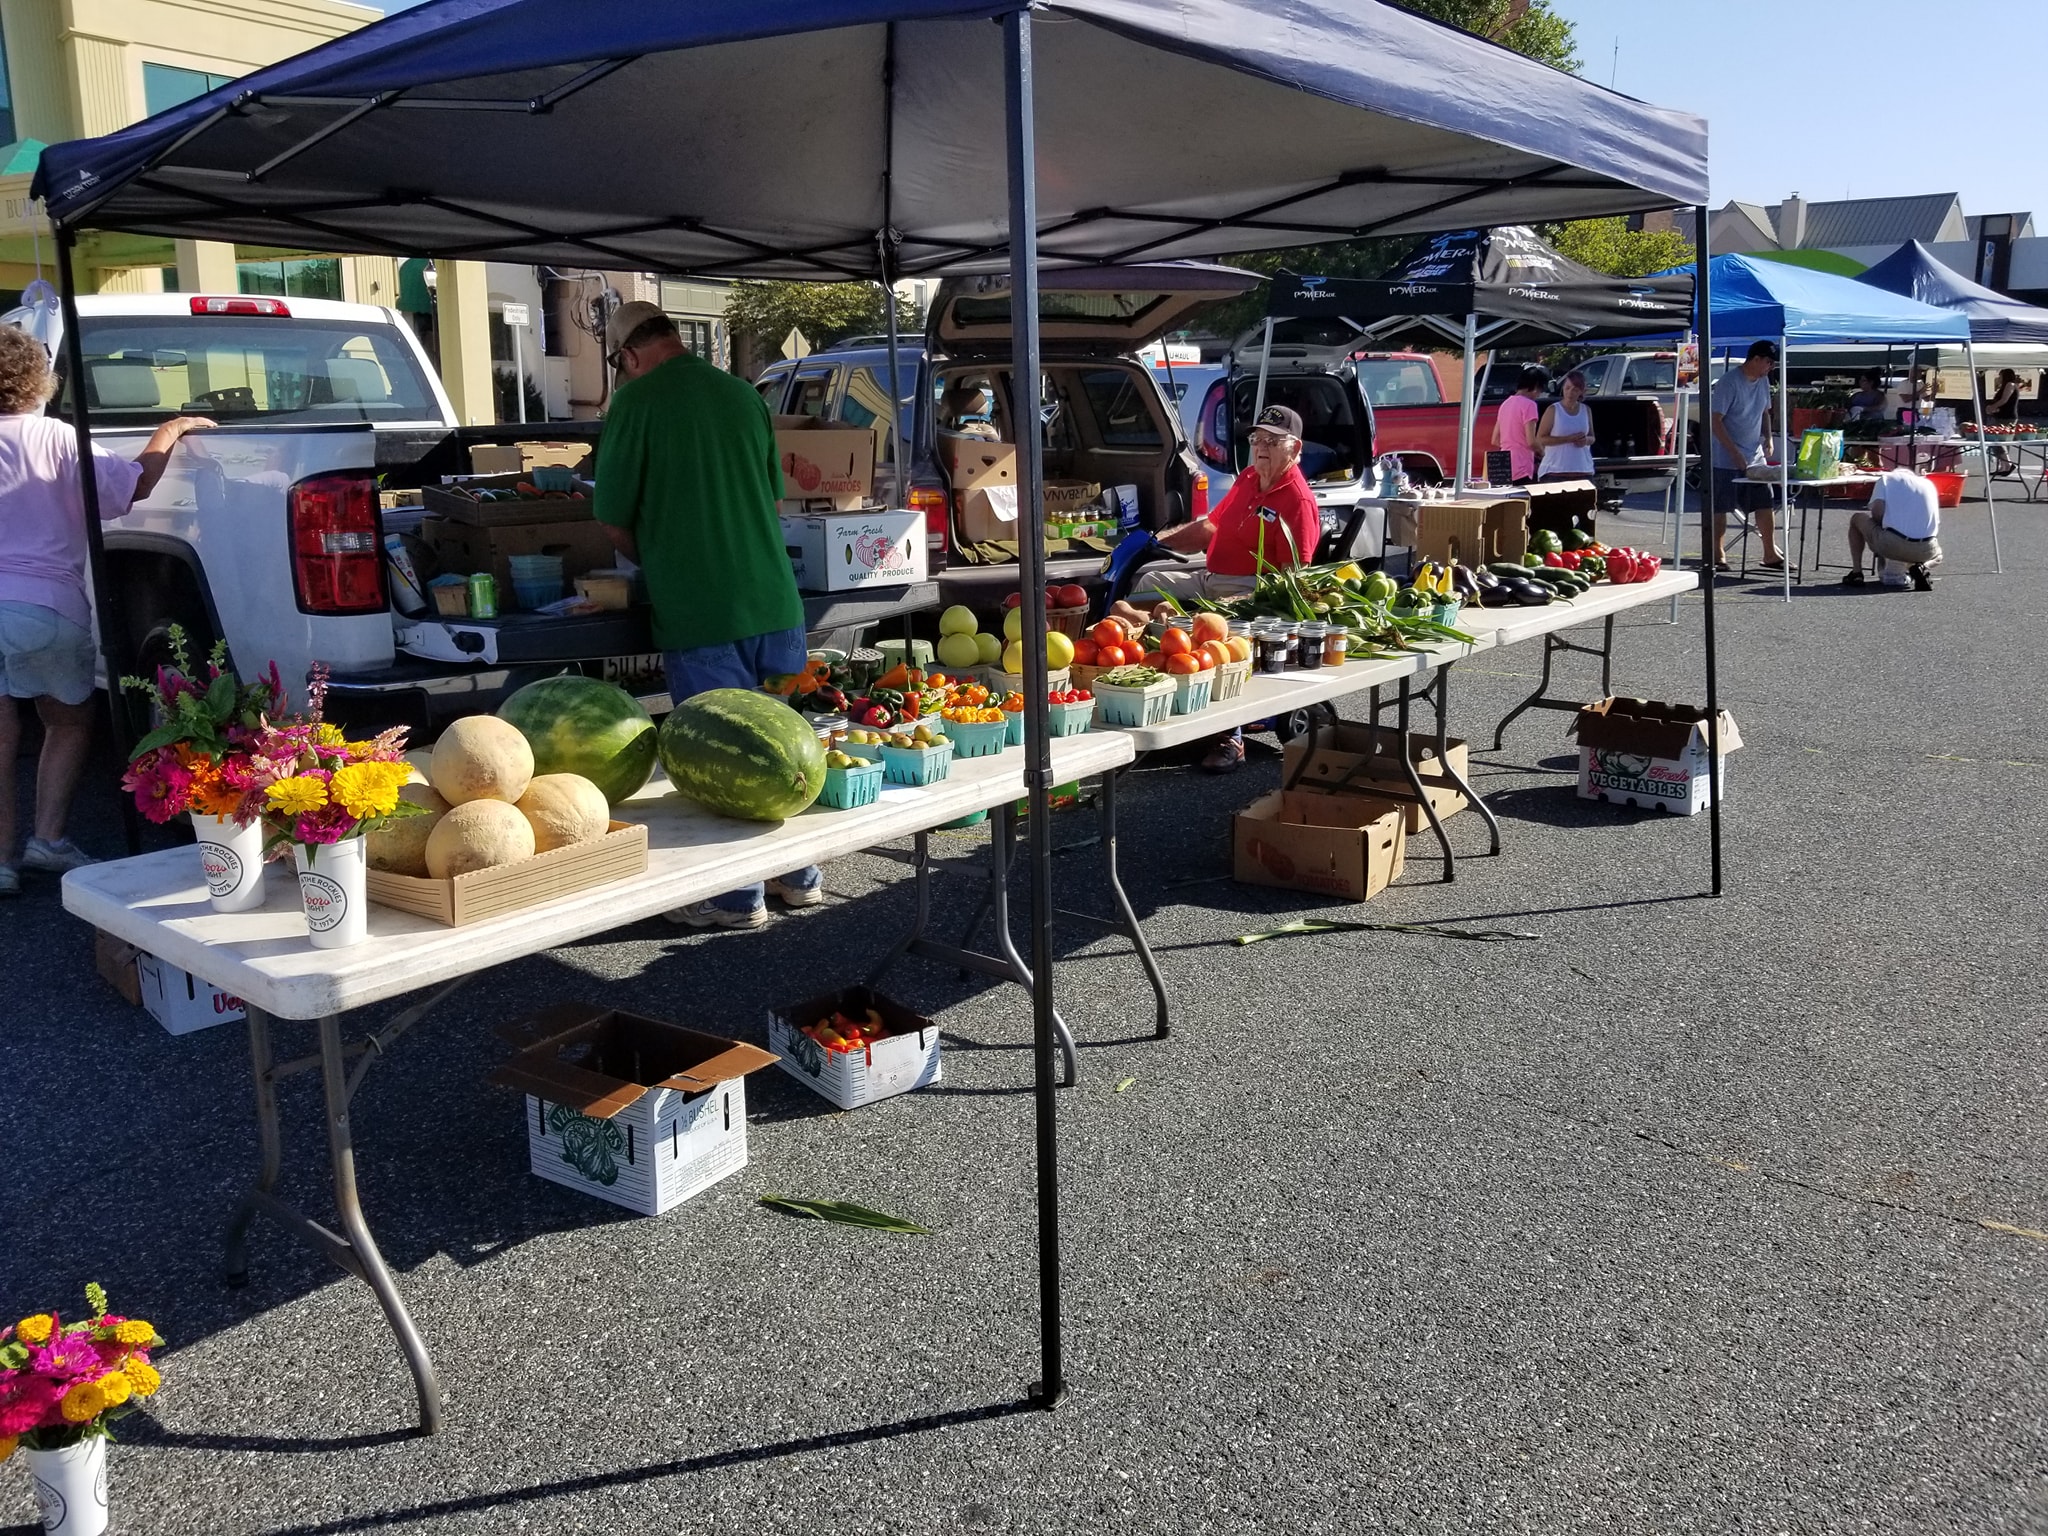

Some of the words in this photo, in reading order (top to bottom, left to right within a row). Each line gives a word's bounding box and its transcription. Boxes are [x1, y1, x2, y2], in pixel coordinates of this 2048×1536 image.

[1294, 291, 1336, 299] POWERADE
[1389, 286, 1439, 295] POWERADE
[1508, 287, 1560, 300] POWERADE
[1618, 299, 1666, 310] POWERADE
[821, 479, 862, 493] TOMATOES
[1042, 487, 1096, 501] TURBANA
[836, 526, 859, 539] Farm
[861, 524, 884, 536] Fresh
[848, 571, 878, 582] QUALITY
[882, 567, 914, 578] PRODUCE
[1647, 766, 1690, 782] Fresh
[1589, 771, 1686, 798] VEGETABLES
[213, 847, 239, 870] ROCKIES
[303, 876, 316, 884] THE
[317, 879, 343, 904] ROCKIES
[688, 1099, 720, 1125] BUSHEL
